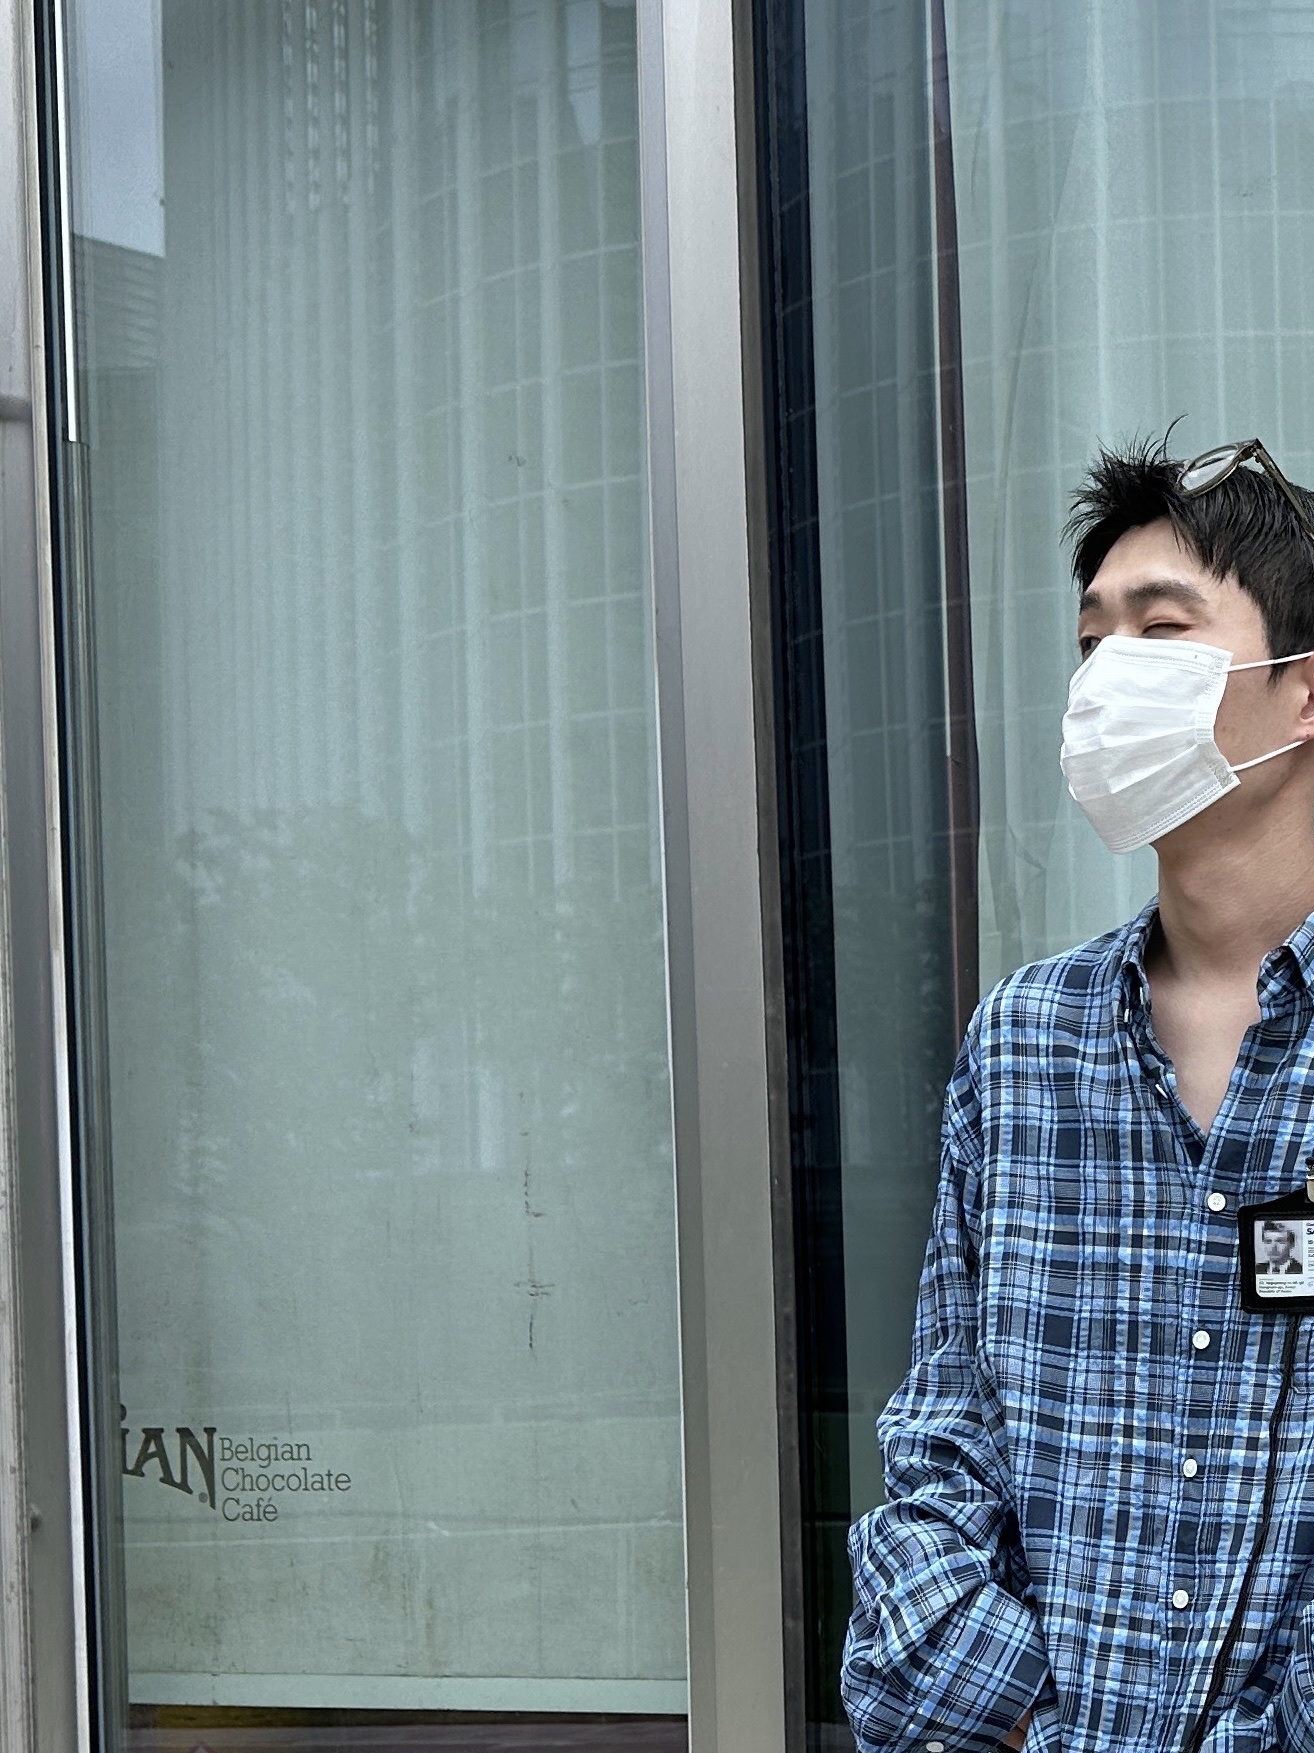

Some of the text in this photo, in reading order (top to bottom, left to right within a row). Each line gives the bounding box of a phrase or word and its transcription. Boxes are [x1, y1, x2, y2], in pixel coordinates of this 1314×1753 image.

[219, 1436, 312, 1468] Belgian
[221, 1467, 352, 1492] Chocolate
[222, 1497, 278, 1522] Café
